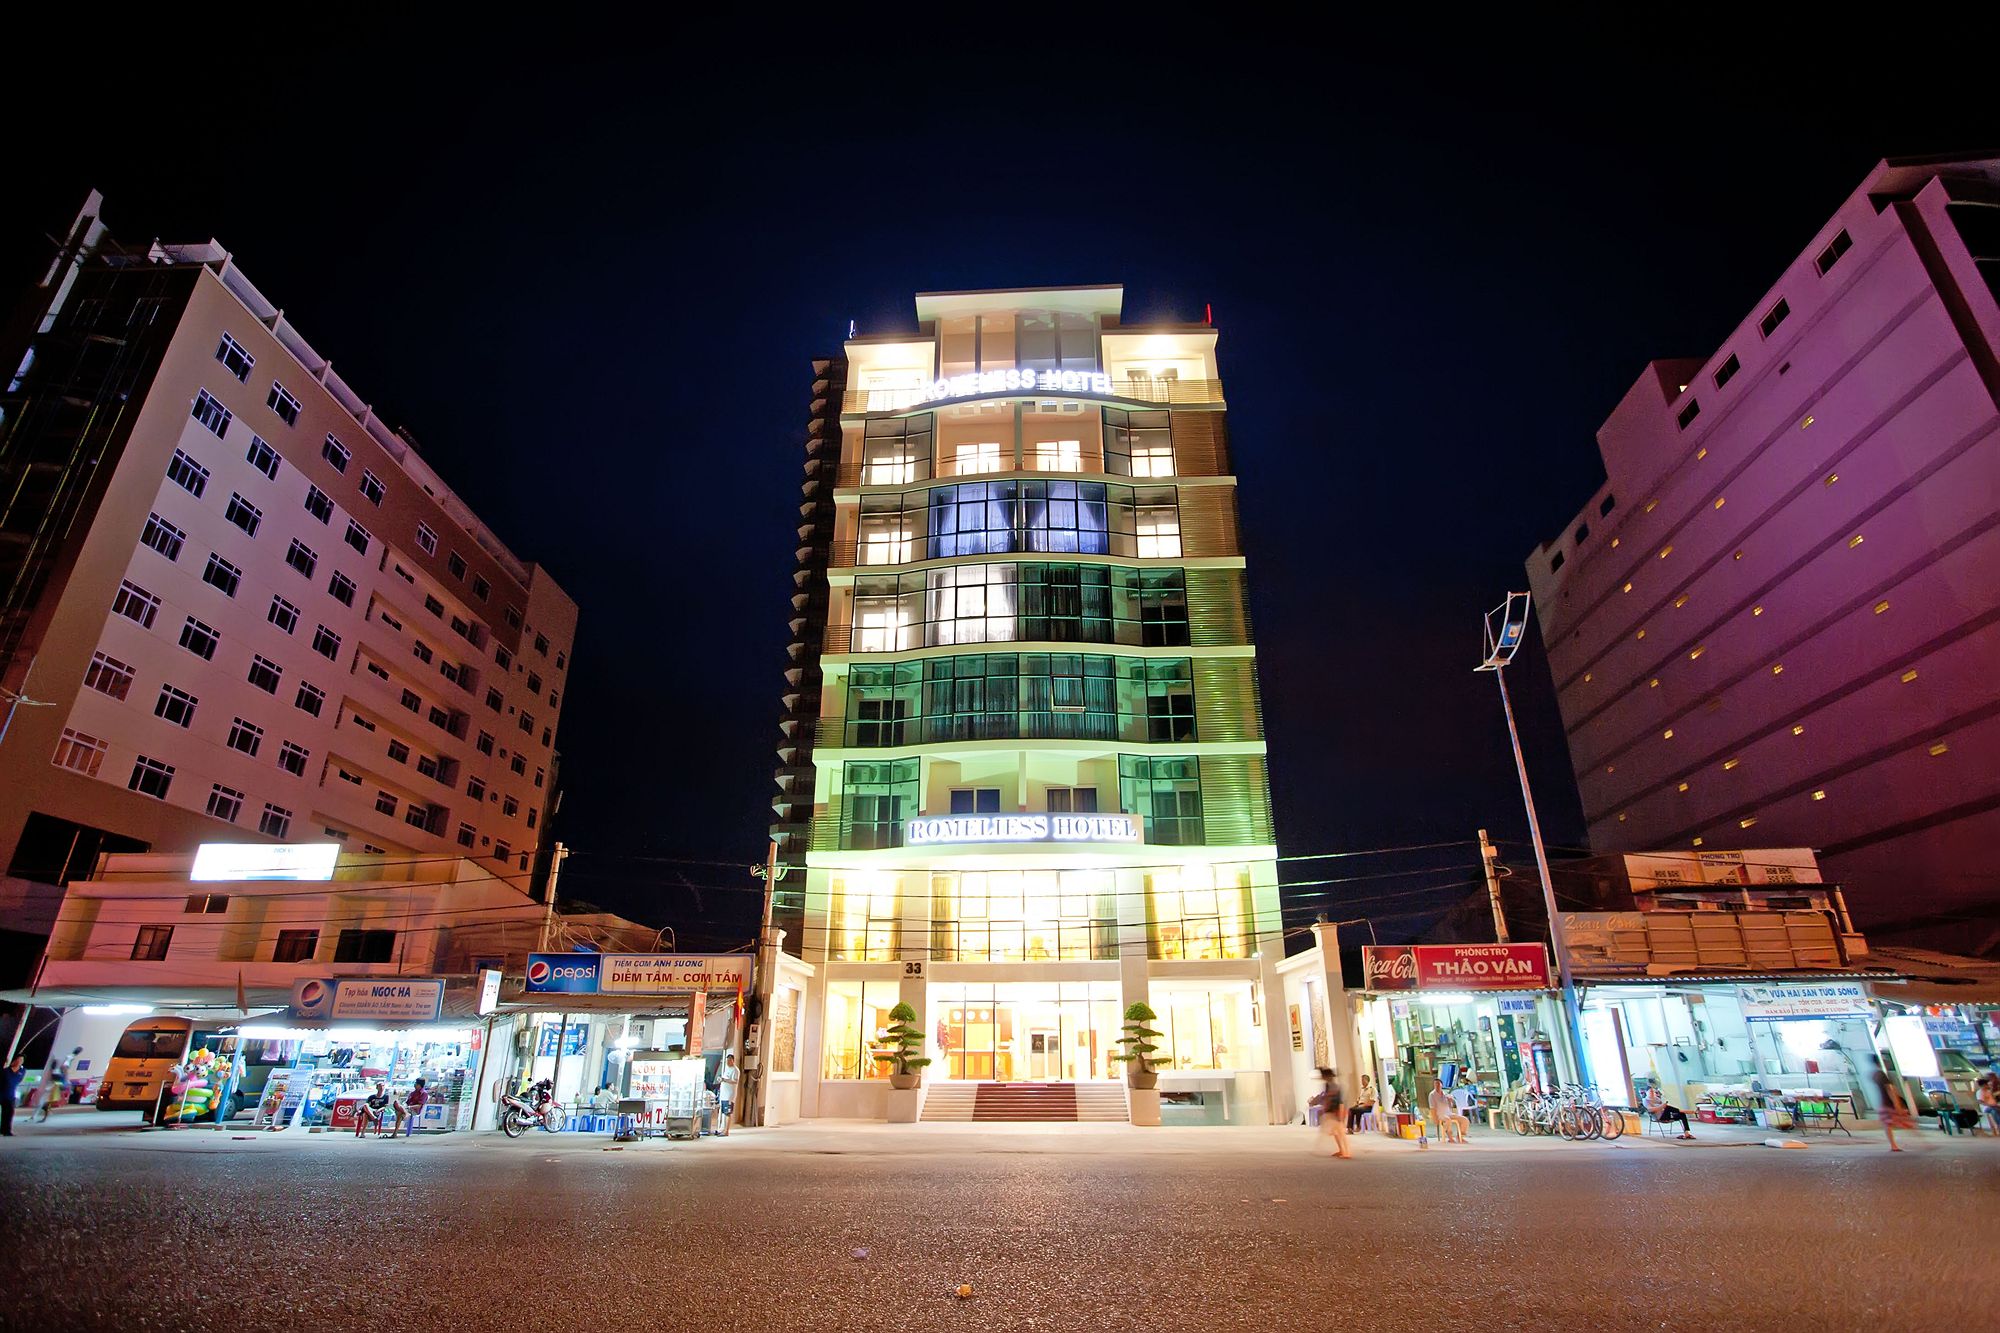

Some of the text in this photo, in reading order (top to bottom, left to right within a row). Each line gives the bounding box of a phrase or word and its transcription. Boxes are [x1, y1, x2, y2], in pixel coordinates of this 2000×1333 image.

[1046, 369, 1114, 393] HOTEL
[910, 816, 1138, 840] ROMELIESS HOTEL
[553, 965, 596, 981] pepsi
[906, 962, 922, 974] 33
[1433, 957, 1533, 975] THẢO VÂN
[646, 970, 672, 982] TÂM
[683, 972, 711, 983] CƠM
[715, 969, 742, 983] TẤM
